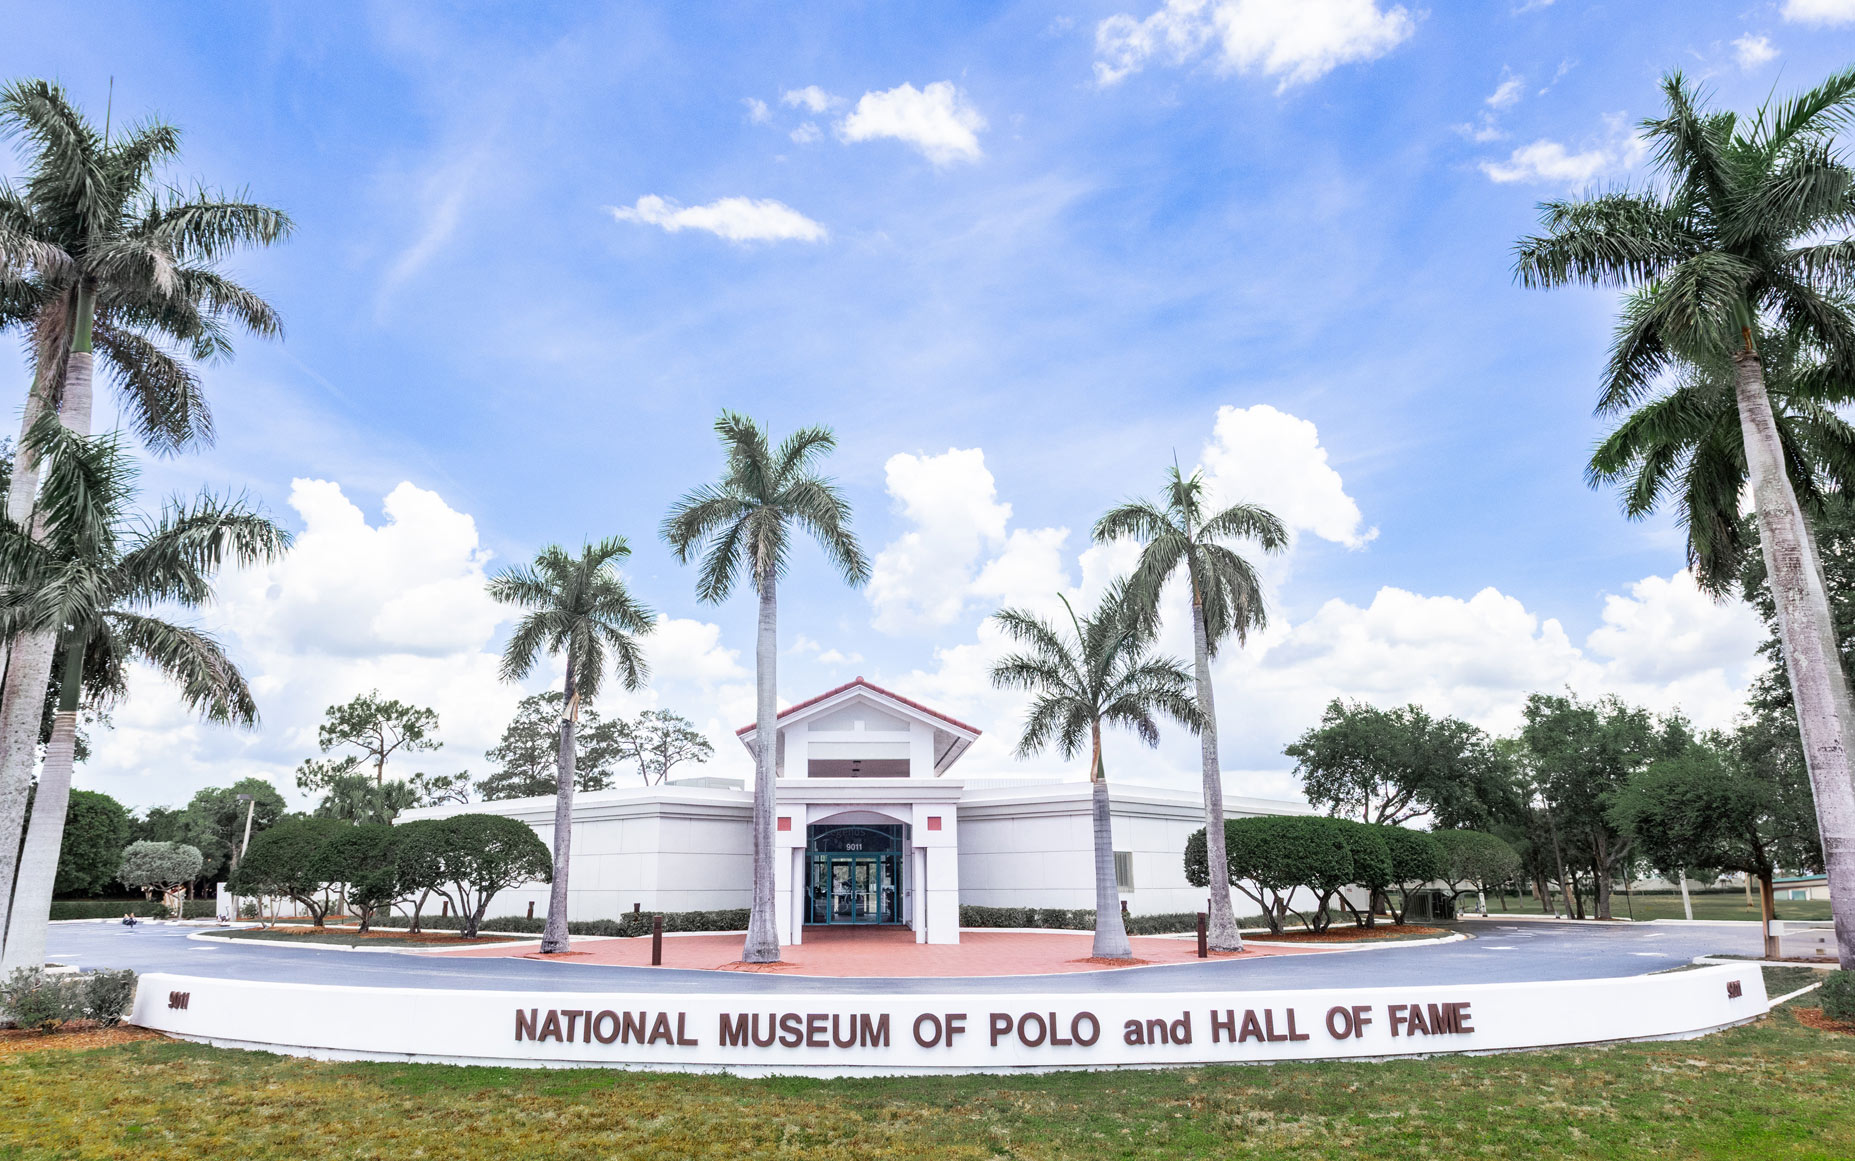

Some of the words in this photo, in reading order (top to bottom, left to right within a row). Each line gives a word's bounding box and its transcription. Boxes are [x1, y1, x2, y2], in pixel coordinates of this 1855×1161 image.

[846, 843, 862, 851] 9011
[168, 991, 190, 1010] 9011
[515, 1008, 698, 1046] NATIONAL
[719, 1012, 890, 1049] MUSEUM
[913, 1012, 967, 1048] OF
[989, 1011, 1101, 1048] POLO
[1124, 1010, 1193, 1045] and
[1211, 1007, 1310, 1043] HALL
[1326, 1005, 1373, 1040] OF
[1387, 1001, 1475, 1037] FAME
